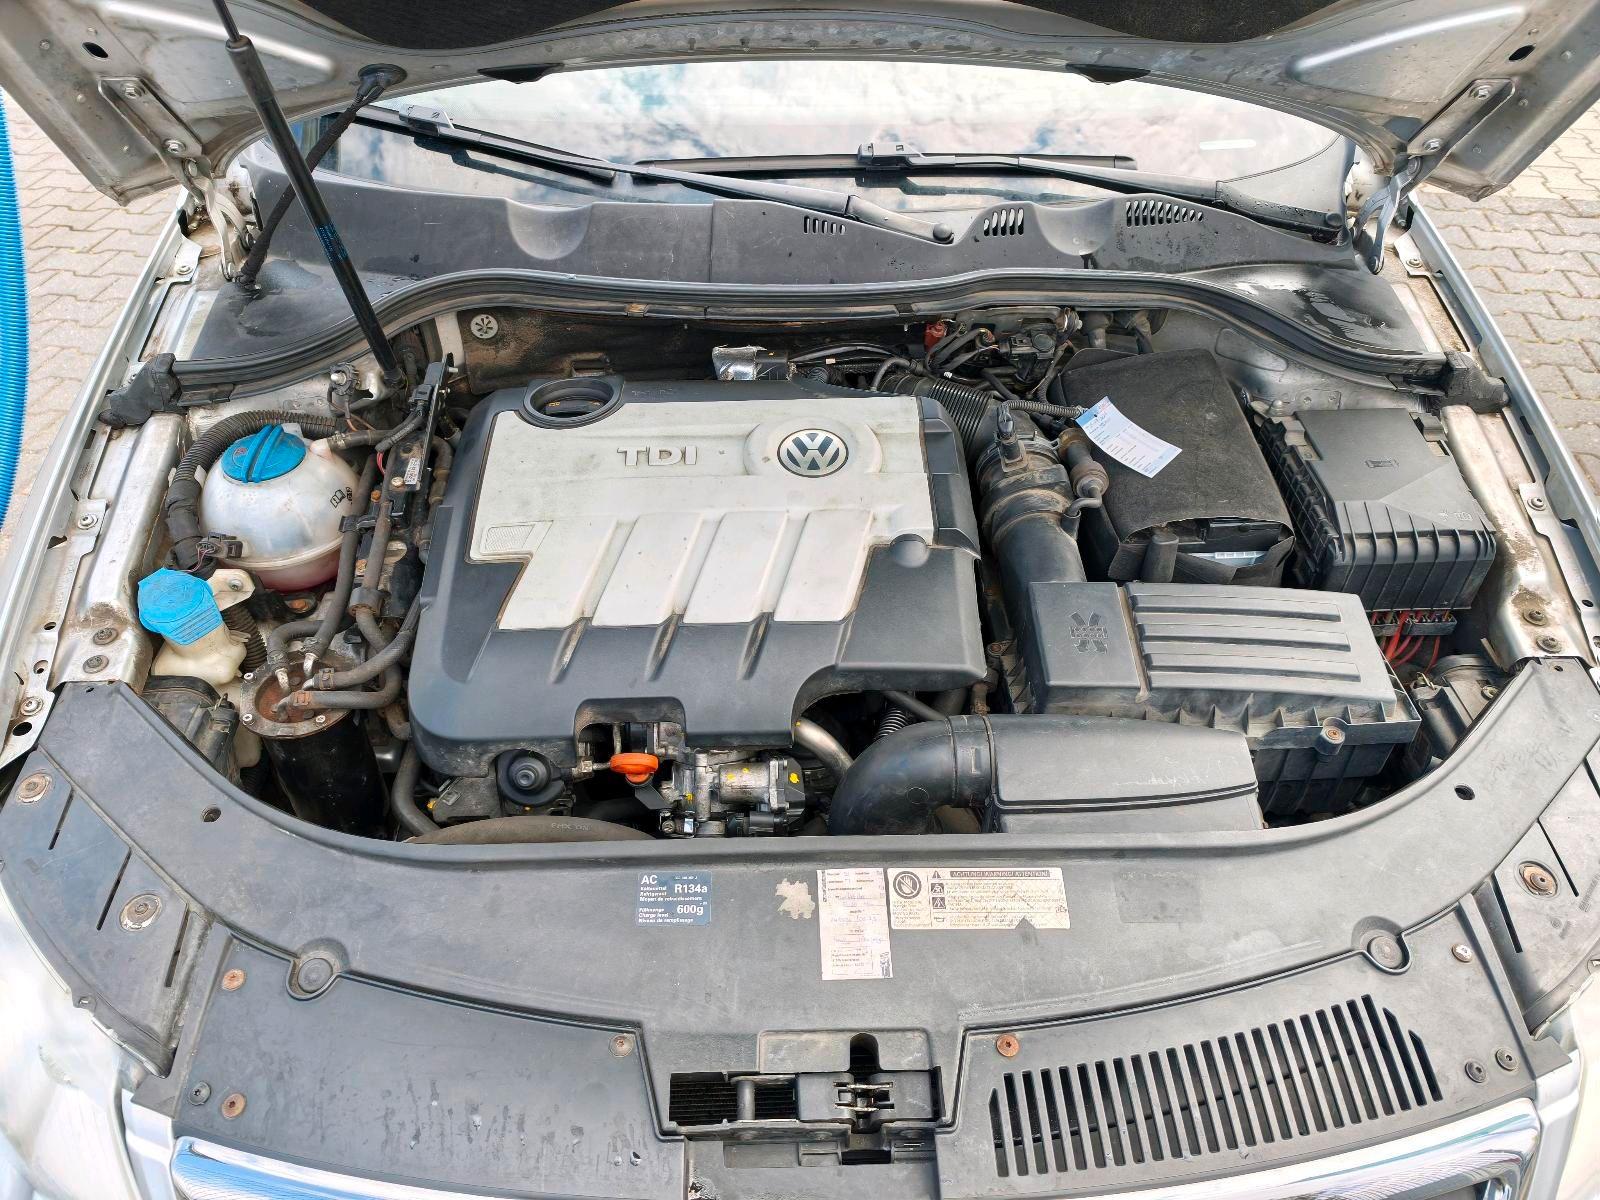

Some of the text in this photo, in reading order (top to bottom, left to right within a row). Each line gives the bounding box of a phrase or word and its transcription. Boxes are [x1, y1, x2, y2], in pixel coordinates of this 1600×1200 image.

[617, 446, 697, 466] TDI
[781, 430, 846, 476] VW
[641, 875, 658, 884] AC
[675, 884, 708, 893] R134a
[677, 905, 704, 916] 600g
